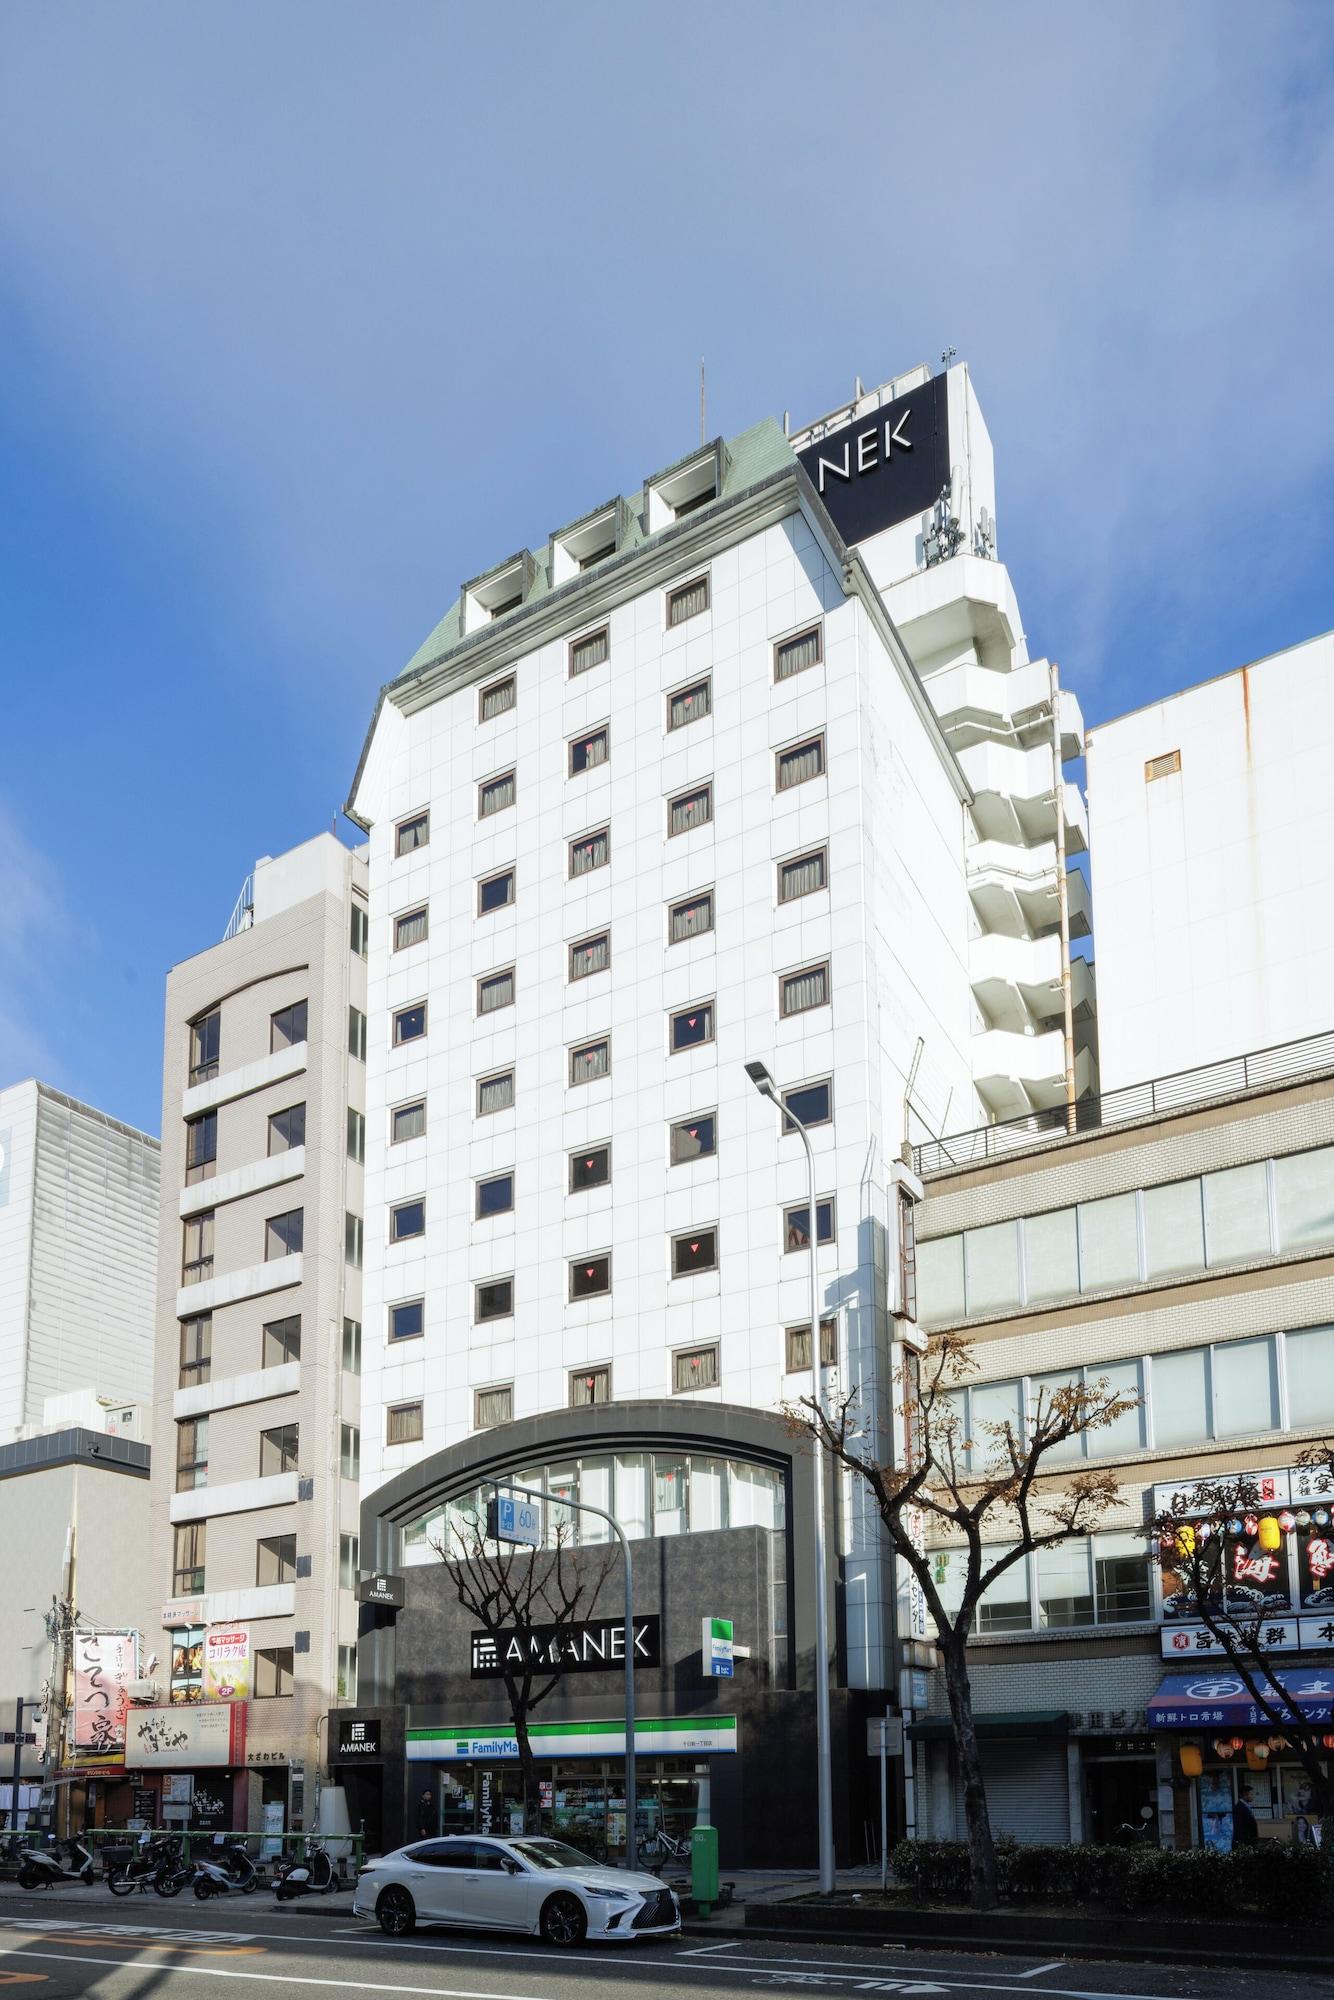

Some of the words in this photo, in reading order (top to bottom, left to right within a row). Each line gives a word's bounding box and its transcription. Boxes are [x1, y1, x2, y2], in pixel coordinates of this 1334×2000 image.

[504, 1502, 512, 1519] P
[369, 1592, 394, 1601] AMANEK
[221, 1687, 233, 1695] 2F
[1155, 1711, 1225, 1723] 新鮮トロ市場
[340, 1742, 376, 1753] AMANEK
[472, 1740, 518, 1754] FamilyMa
[480, 1772, 492, 1833] FamilyMa
